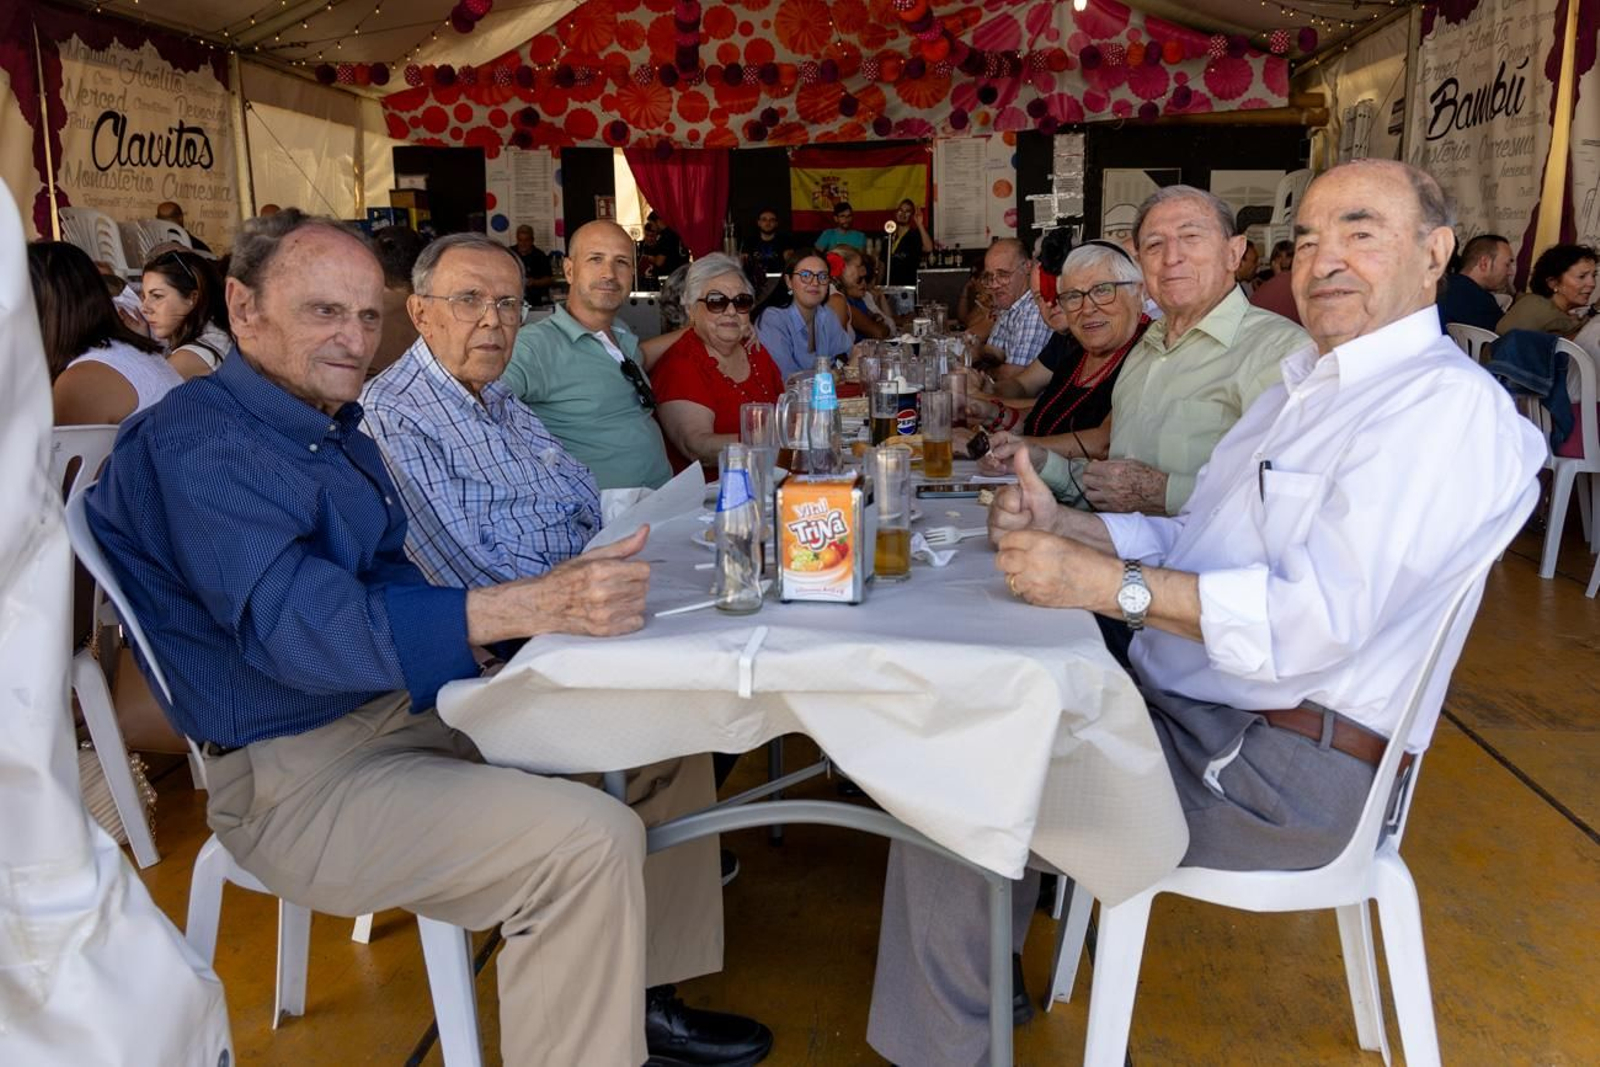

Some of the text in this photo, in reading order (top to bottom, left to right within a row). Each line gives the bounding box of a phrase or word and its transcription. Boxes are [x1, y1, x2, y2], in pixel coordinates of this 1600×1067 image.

[65, 79, 128, 113] Merced
[1427, 57, 1527, 140] Bambú
[92, 110, 214, 172] Clavitos
[65, 160, 155, 193] Monasterio
